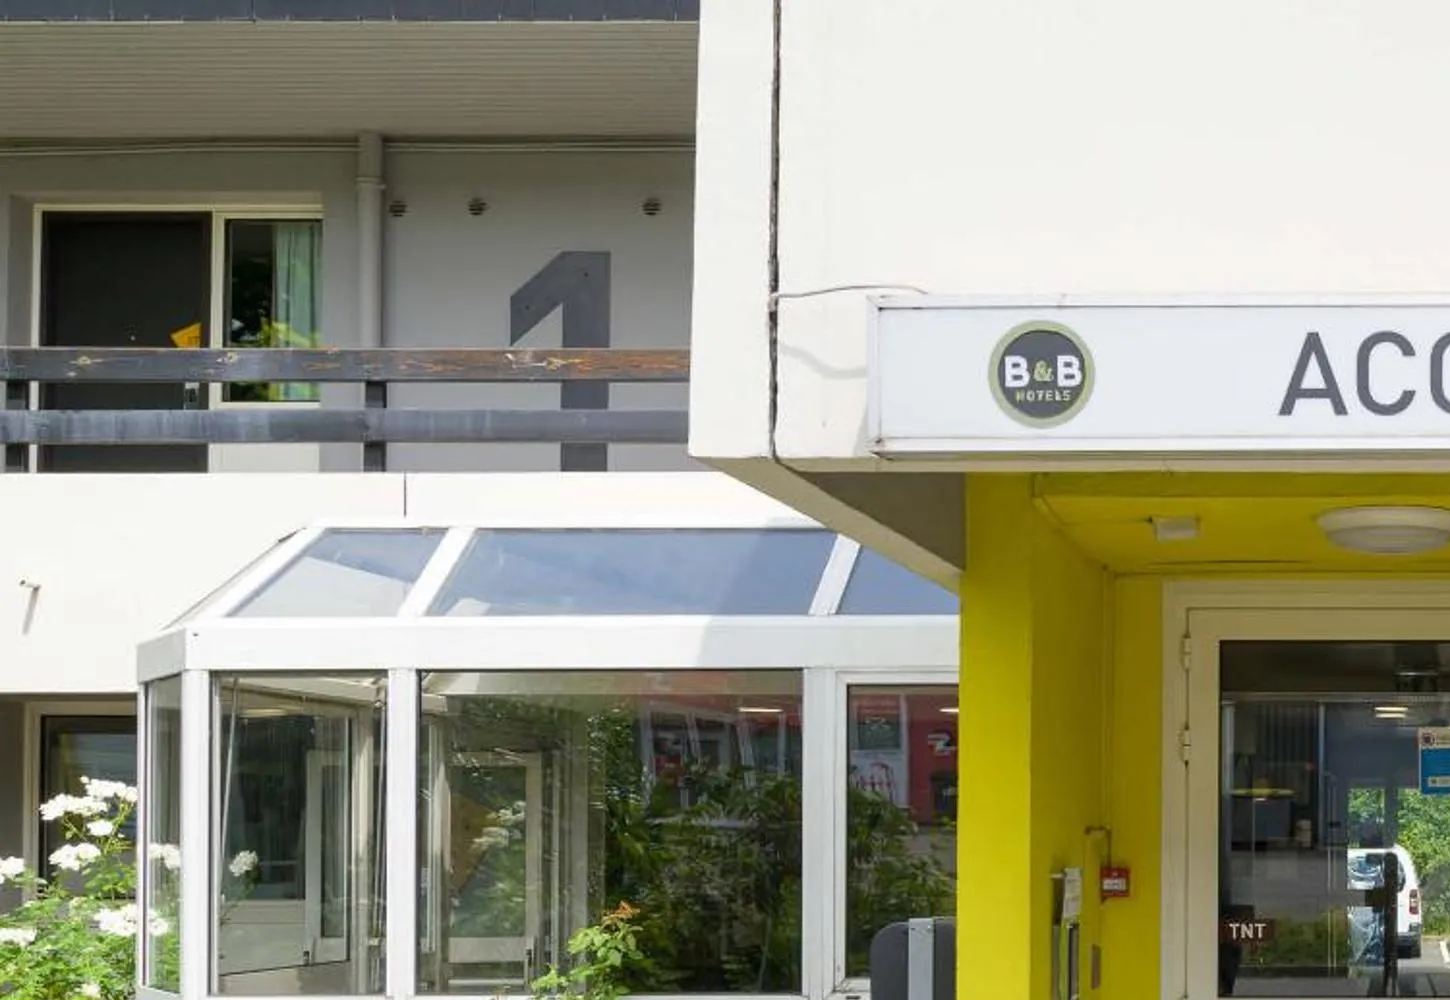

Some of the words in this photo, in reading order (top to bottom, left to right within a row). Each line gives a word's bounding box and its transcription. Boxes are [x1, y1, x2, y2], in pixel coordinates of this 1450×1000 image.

[510, 251, 611, 472] 1
[1003, 355, 1082, 388] B&B
[1015, 389, 1071, 402] HOTELS
[1228, 923, 1268, 940] TNT
